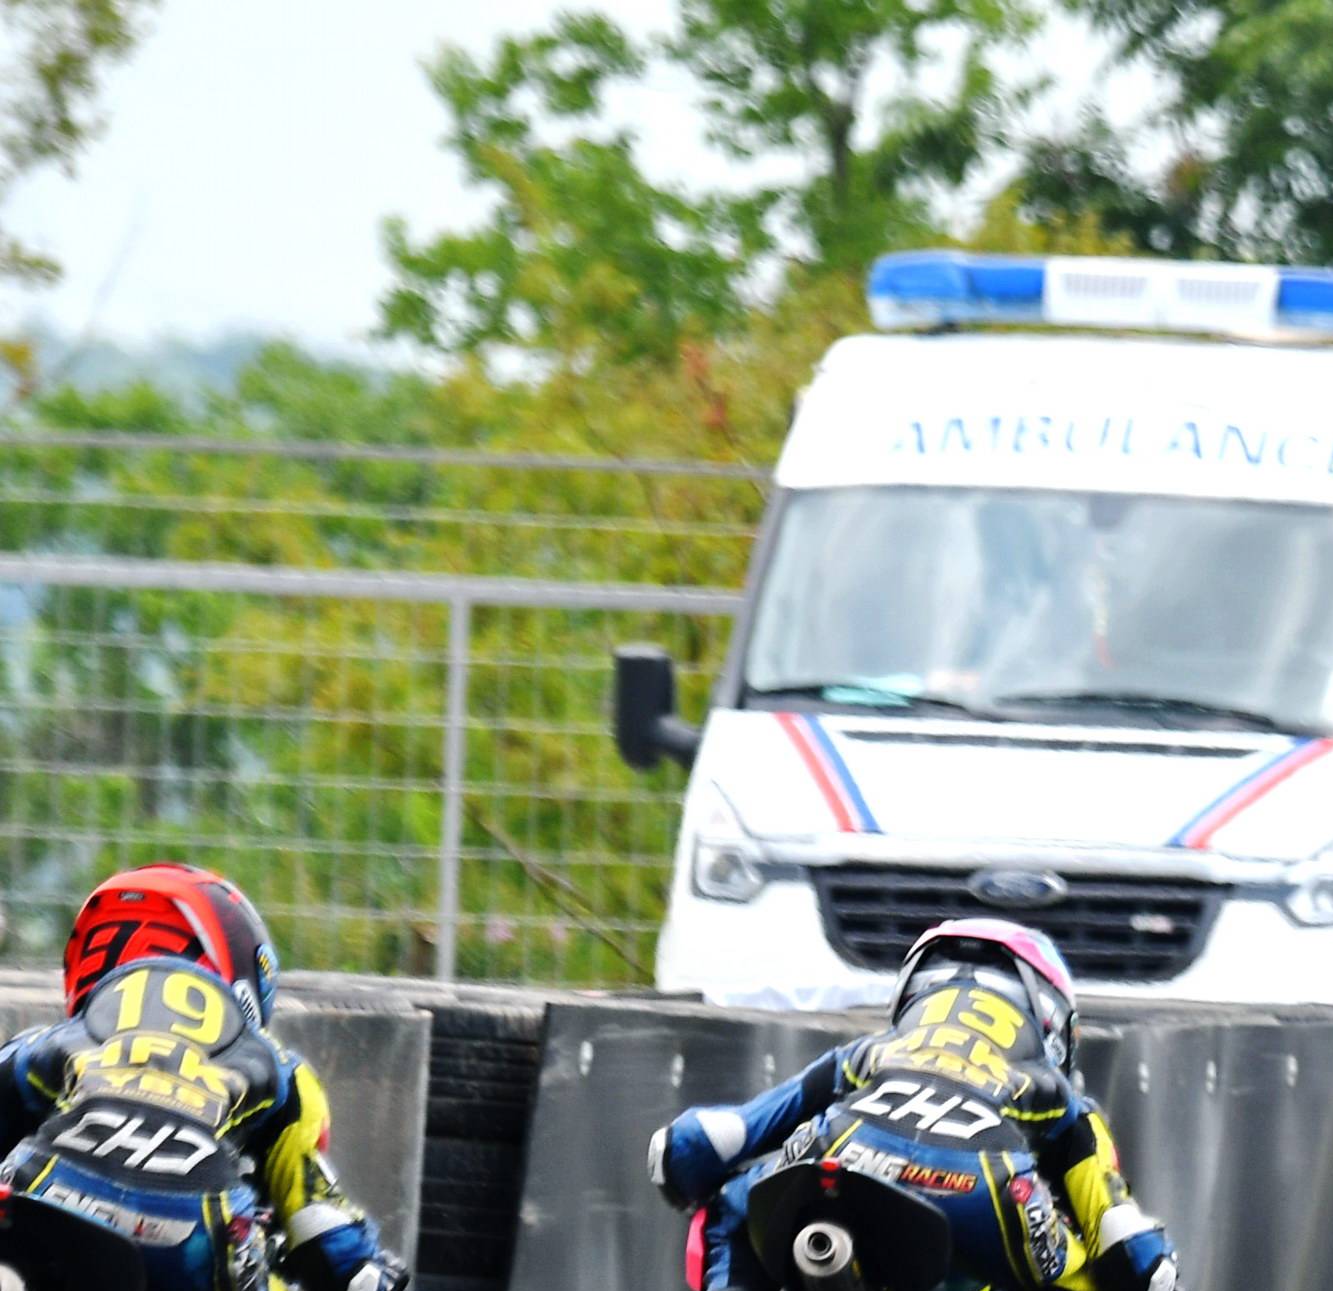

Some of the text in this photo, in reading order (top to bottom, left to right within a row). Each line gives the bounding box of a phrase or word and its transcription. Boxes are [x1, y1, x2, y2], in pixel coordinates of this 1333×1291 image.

[113, 969, 225, 1045] 19
[919, 988, 1025, 1050] 13
[900, 1163, 978, 1194] RACING
